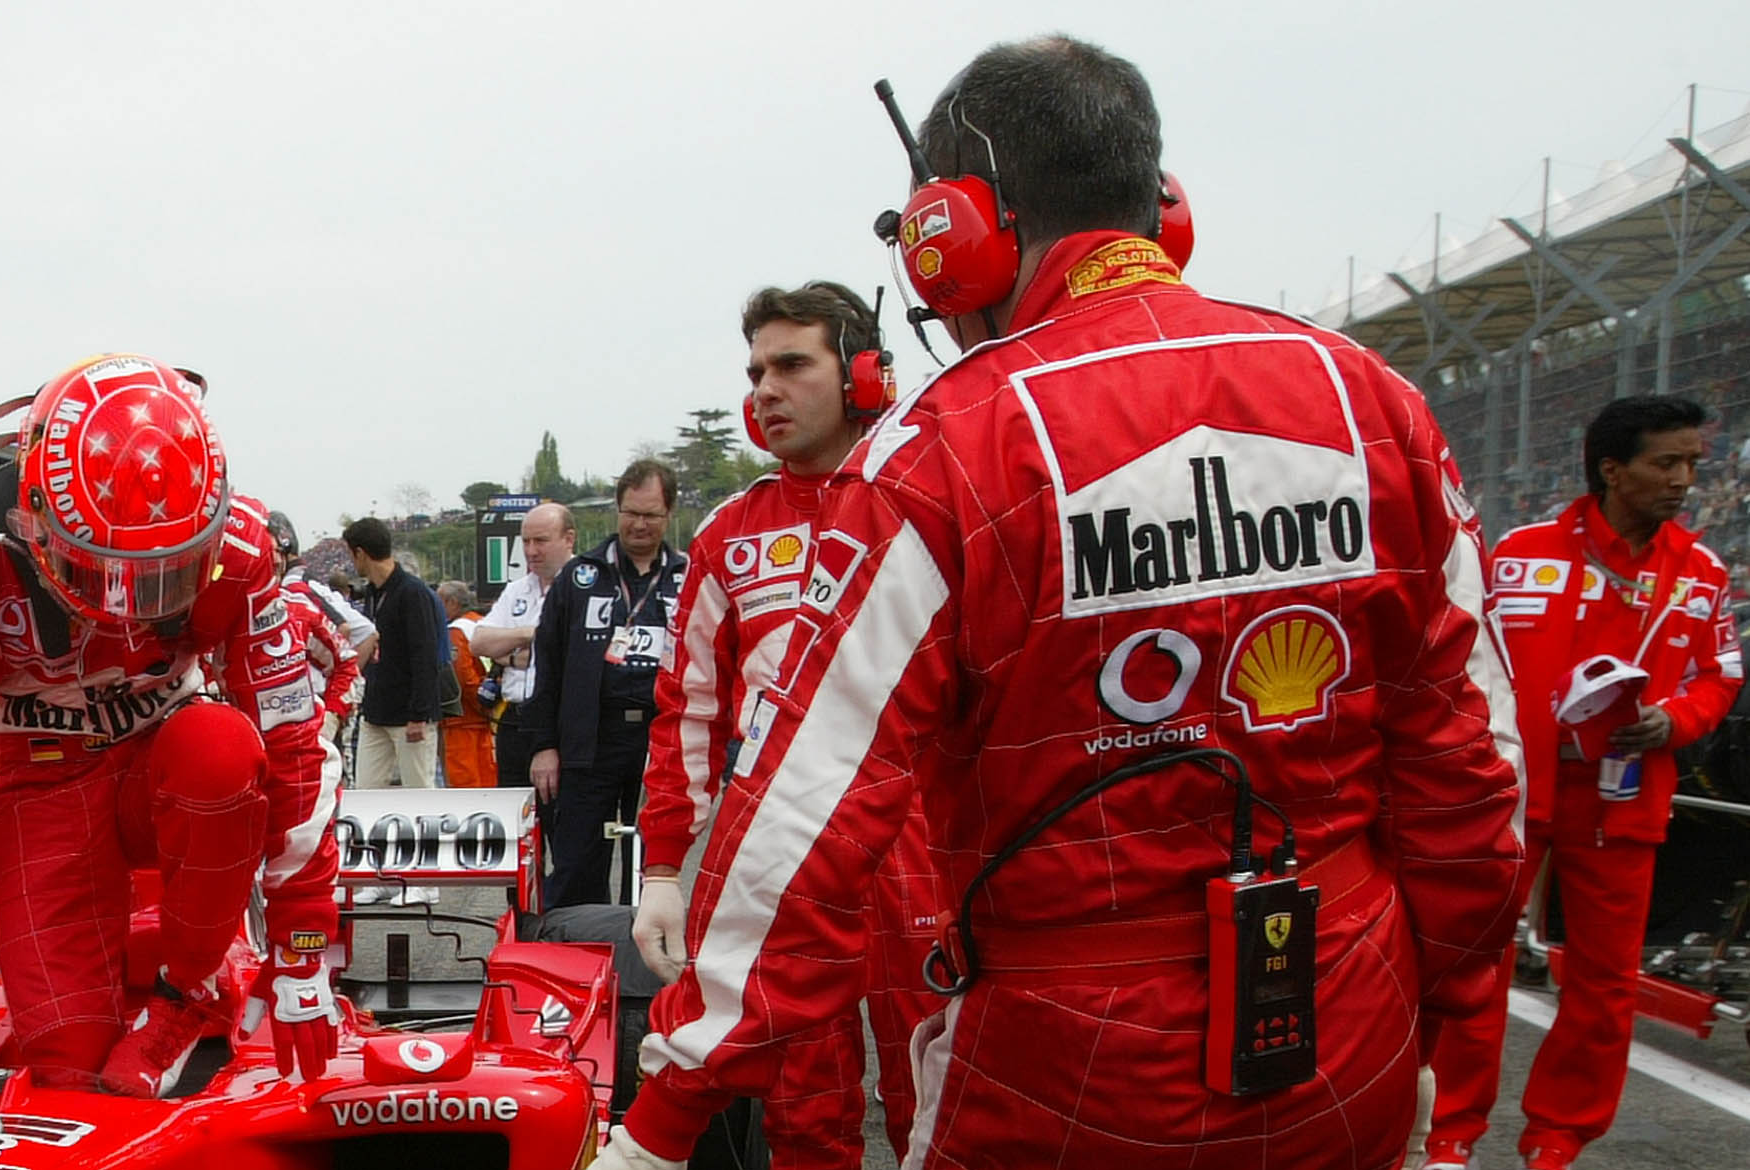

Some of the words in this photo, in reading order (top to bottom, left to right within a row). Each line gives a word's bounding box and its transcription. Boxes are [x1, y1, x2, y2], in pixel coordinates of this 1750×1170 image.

[48, 398, 94, 542] Marlboro
[1068, 456, 1364, 600] Marlboro
[1084, 723, 1207, 756] vodafone
[332, 1091, 519, 1127] vodafone
